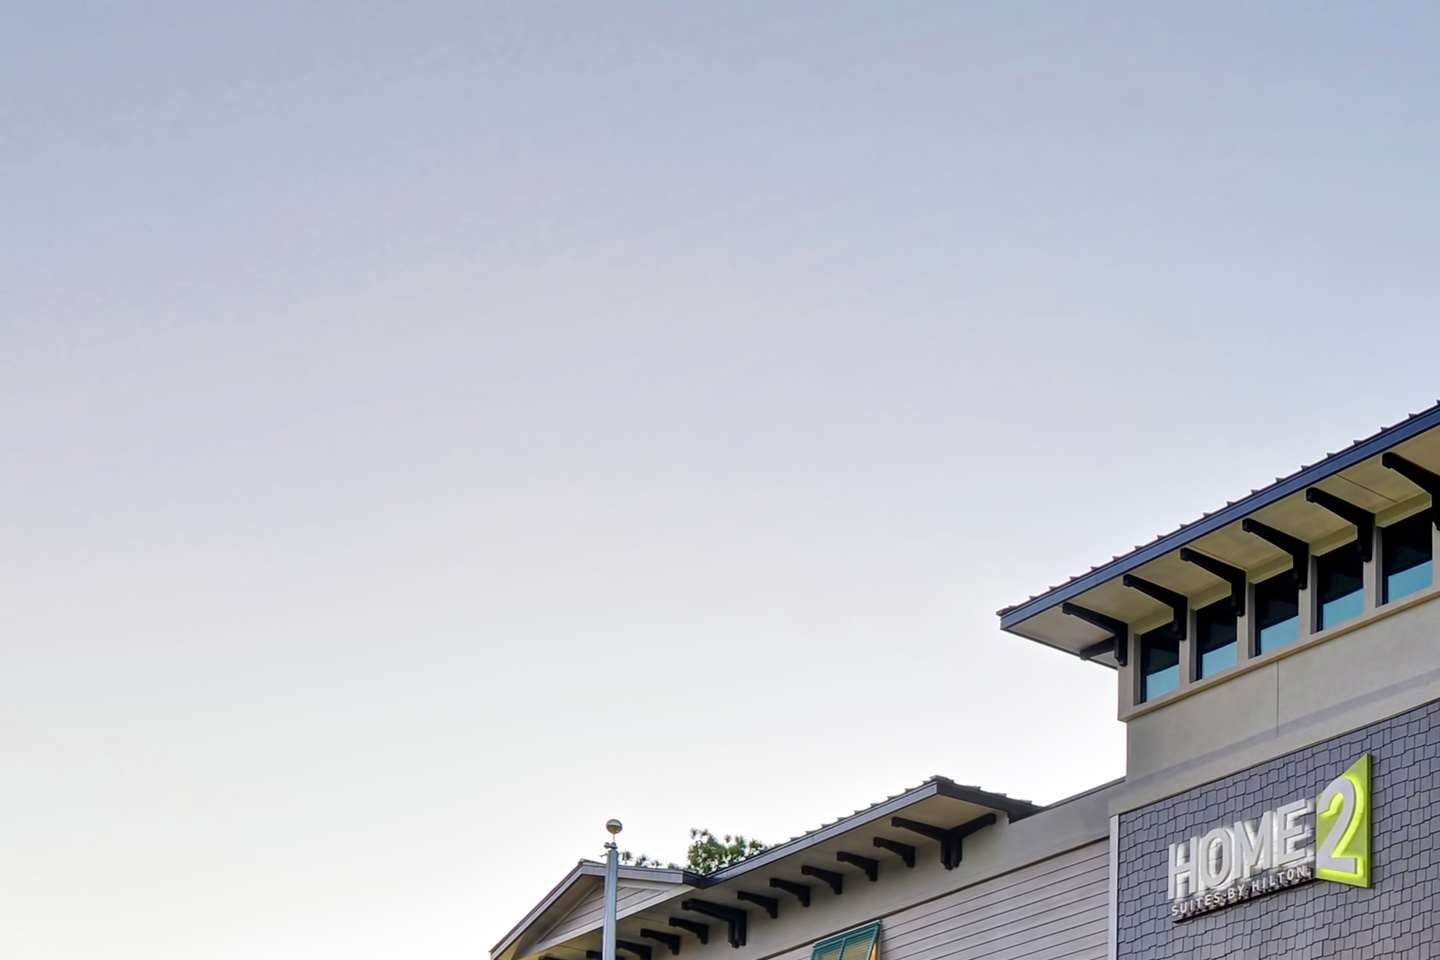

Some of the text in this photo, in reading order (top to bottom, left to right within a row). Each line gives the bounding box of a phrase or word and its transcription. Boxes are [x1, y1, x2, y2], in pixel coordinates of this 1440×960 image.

[1171, 865, 1308, 916] SUITES BY HILTON
